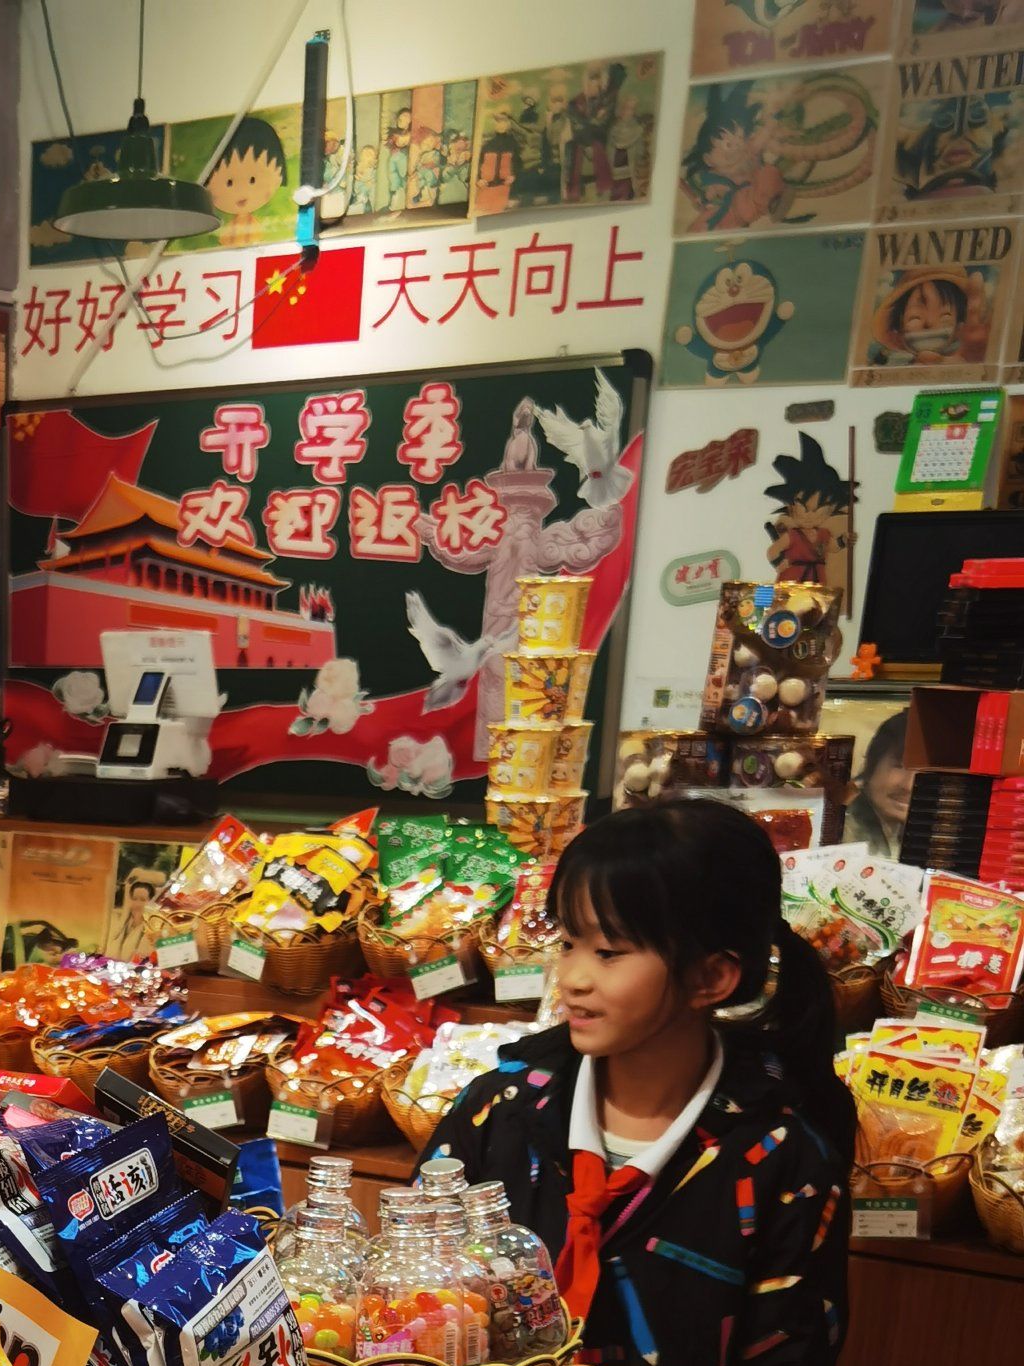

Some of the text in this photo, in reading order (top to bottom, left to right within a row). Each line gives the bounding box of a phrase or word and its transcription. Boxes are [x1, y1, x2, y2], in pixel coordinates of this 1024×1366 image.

[373, 226, 644, 330] 天天向上
[877, 225, 1012, 267] WANTED
[20, 269, 244, 359] 好好学习
[200, 382, 463, 485] 开学季
